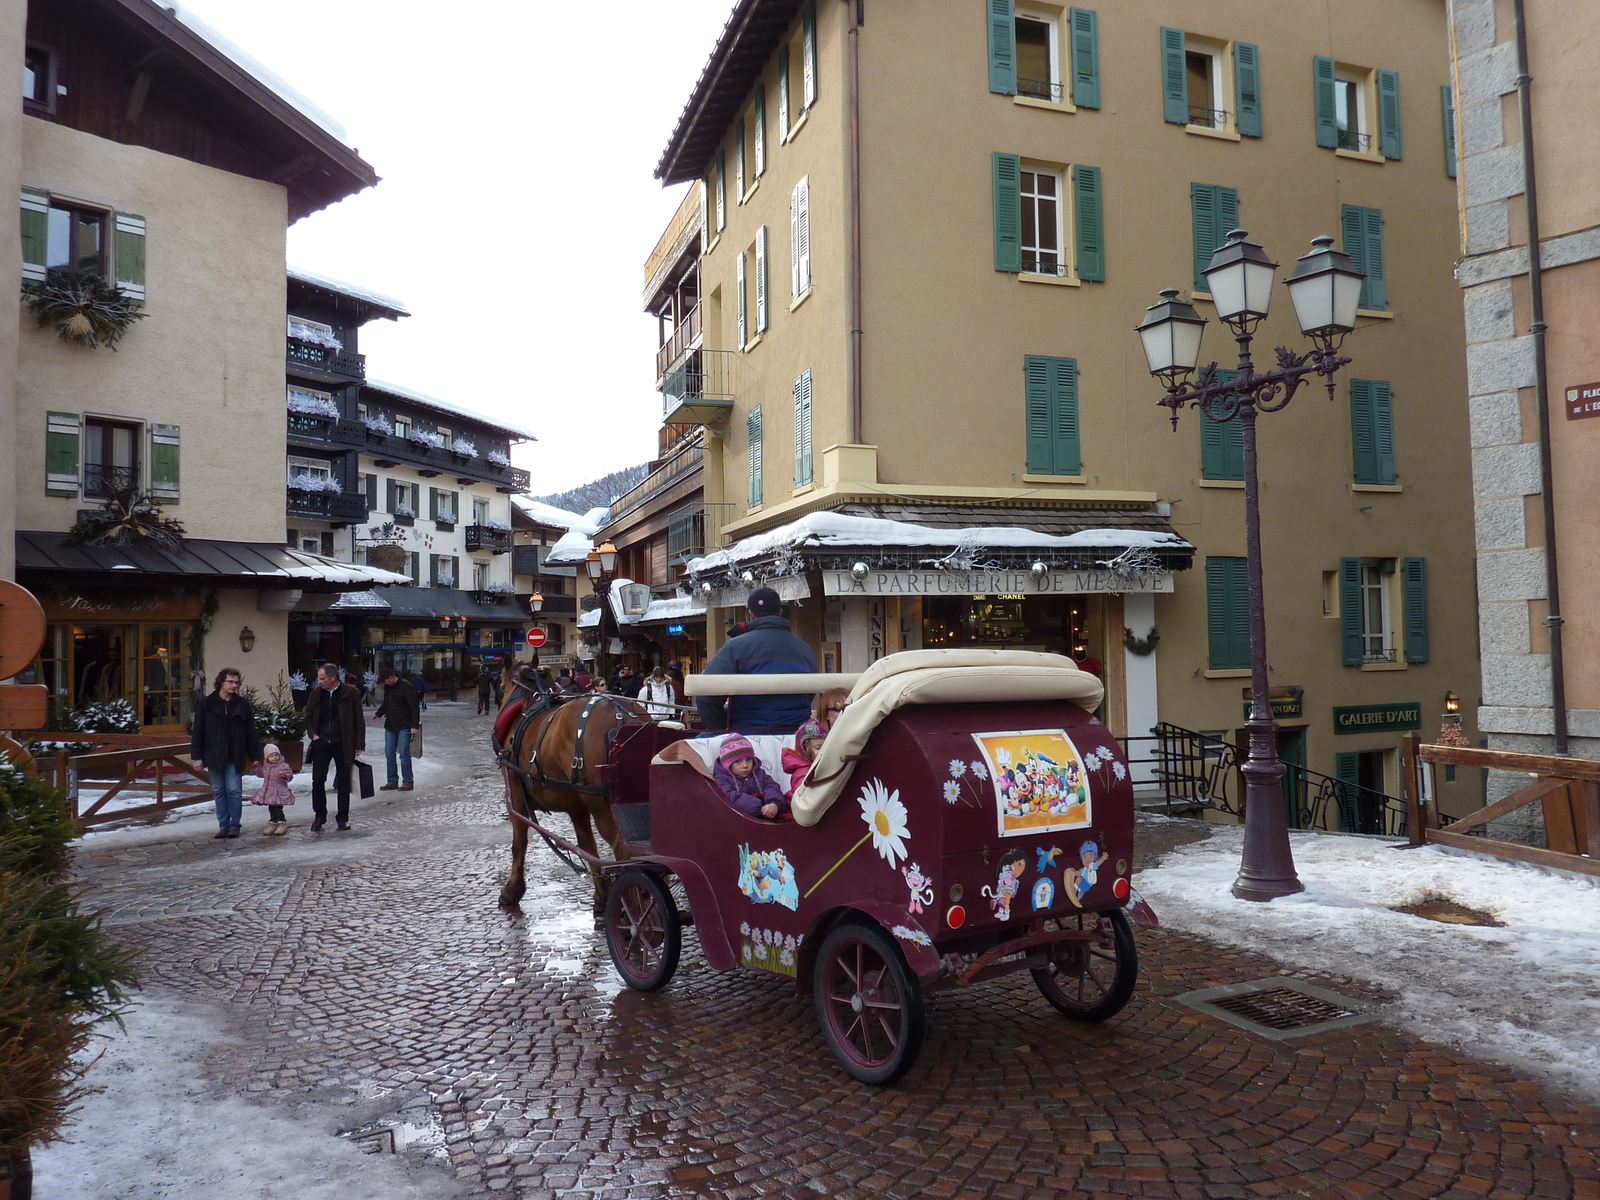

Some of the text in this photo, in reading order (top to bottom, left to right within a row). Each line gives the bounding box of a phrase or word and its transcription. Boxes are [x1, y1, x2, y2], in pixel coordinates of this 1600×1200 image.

[835, 573, 868, 593] LA
[876, 573, 1026, 593] PARFUMERIE
[1036, 573, 1065, 592] DE
[1339, 710, 1419, 726] GALERIE D'ART
